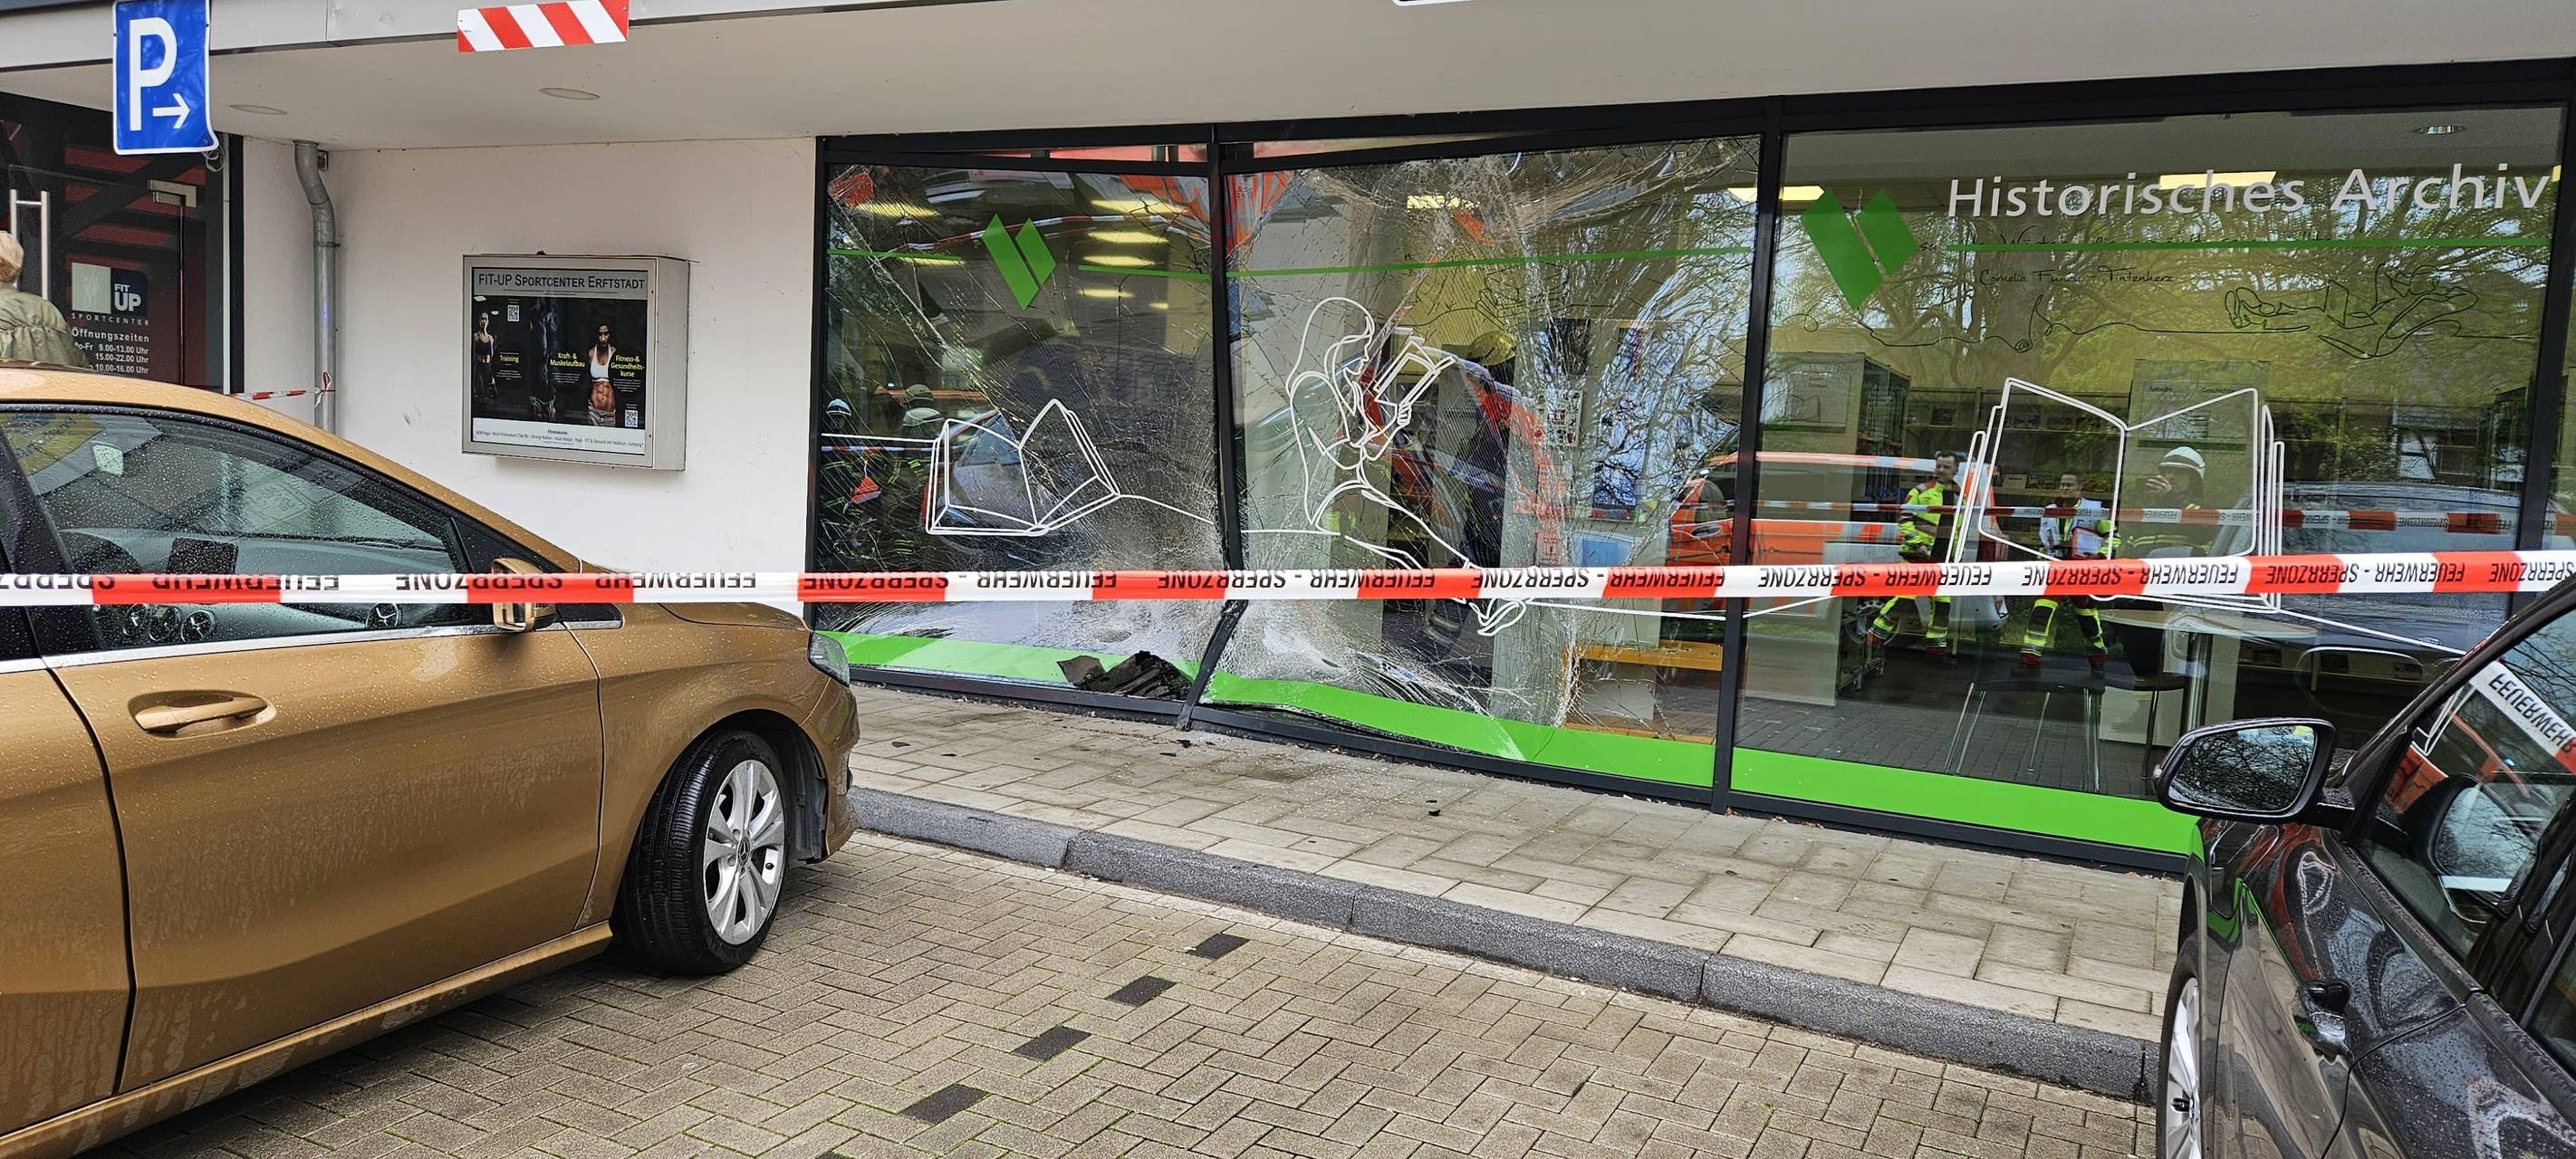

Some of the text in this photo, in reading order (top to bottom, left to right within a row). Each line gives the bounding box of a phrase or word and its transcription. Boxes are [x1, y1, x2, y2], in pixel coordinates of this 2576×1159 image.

[129, 16, 178, 131] P
[1947, 163, 2551, 218] Historisches Archiv
[114, 283, 130, 292] FIT
[478, 273, 512, 286] FIT-UP
[588, 276, 645, 289] ERFTSTADT
[114, 292, 141, 311] UP
[72, 312, 149, 326] SPORTCENTER
[72, 326, 149, 342] Öffnungszeiten
[75, 341, 149, 354] o-Fr 9.00-13.00 Uhr
[95, 352, 149, 363] 15.00-22.00 Uhr
[499, 355, 520, 363] Training
[136, 366, 149, 374] Uhr
[1310, 570, 1436, 589] FEUERWEHR
[1471, 567, 1589, 589] SPERRZONE
[1610, 567, 1725, 588] FEUERWEHR
[1757, 567, 1867, 588] SPERRZONE
[1885, 565, 1992, 587] FEUERWEHR
[2021, 566, 2122, 587] SPERRZONE
[2139, 563, 2239, 585] FEUERWEHR
[2264, 563, 2360, 584] SPERRZONE
[2374, 562, 2465, 582] FEUERWEHR
[2488, 561, 2574, 582] SPERRZONE
